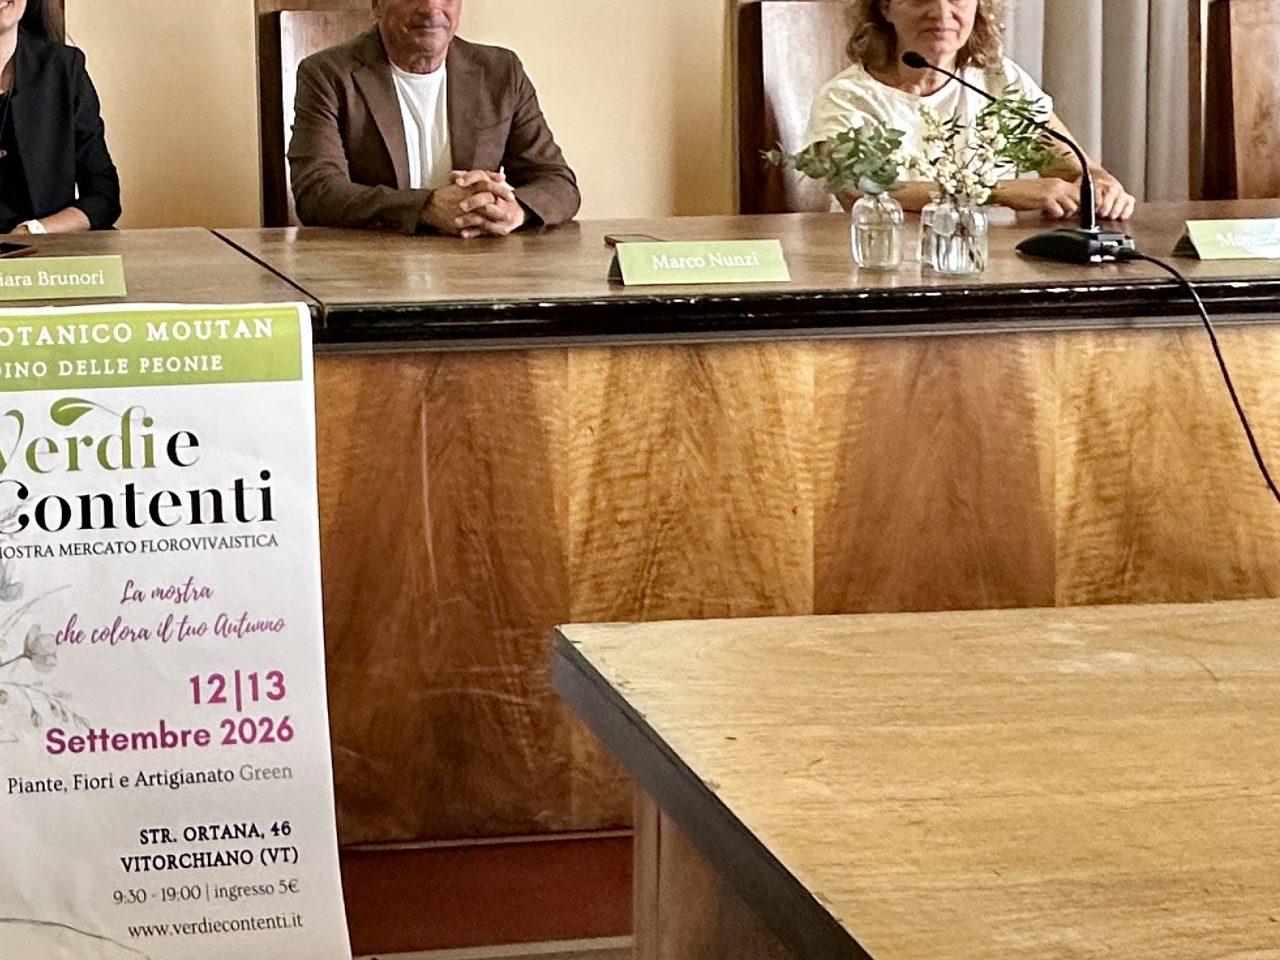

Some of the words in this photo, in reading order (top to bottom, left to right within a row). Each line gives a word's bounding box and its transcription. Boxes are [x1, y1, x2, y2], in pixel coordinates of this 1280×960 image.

[651, 253, 705, 270] Marco
[709, 251, 760, 269] Nunzi
[37, 270, 104, 287] Brunori
[146, 318, 274, 344] MOUTAN
[58, 357, 130, 377] DELLE
[139, 354, 224, 373] PEONIE
[166, 428, 201, 468] e
[59, 540, 137, 557] MERCATO
[140, 534, 279, 554] FLOROVIVAISTICA
[120, 579, 146, 605] La
[151, 576, 213, 605] mostra
[55, 613, 86, 646] che
[90, 616, 151, 646] colora
[156, 613, 175, 644] il
[177, 616, 209, 643] tuo
[213, 610, 286, 640] Autunno
[45, 720, 212, 755] Settembre
[220, 716, 295, 746] 2026
[7, 776, 68, 795] Piante,
[73, 773, 114, 791] Fiori
[120, 777, 129, 788] e
[134, 767, 235, 790] Artigianato
[239, 765, 293, 782] Green
[139, 828, 178, 845] STR.
[183, 823, 265, 842] ORTANA,
[270, 821, 292, 836] 46
[121, 849, 254, 872] VITORCHIANO
[260, 846, 299, 867] (VT)
[161, 885, 202, 902] 19:00
[214, 881, 274, 902] ingresso
[278, 878, 300, 895] 5€
[127, 912, 304, 938] www.verdiecontenti.it
